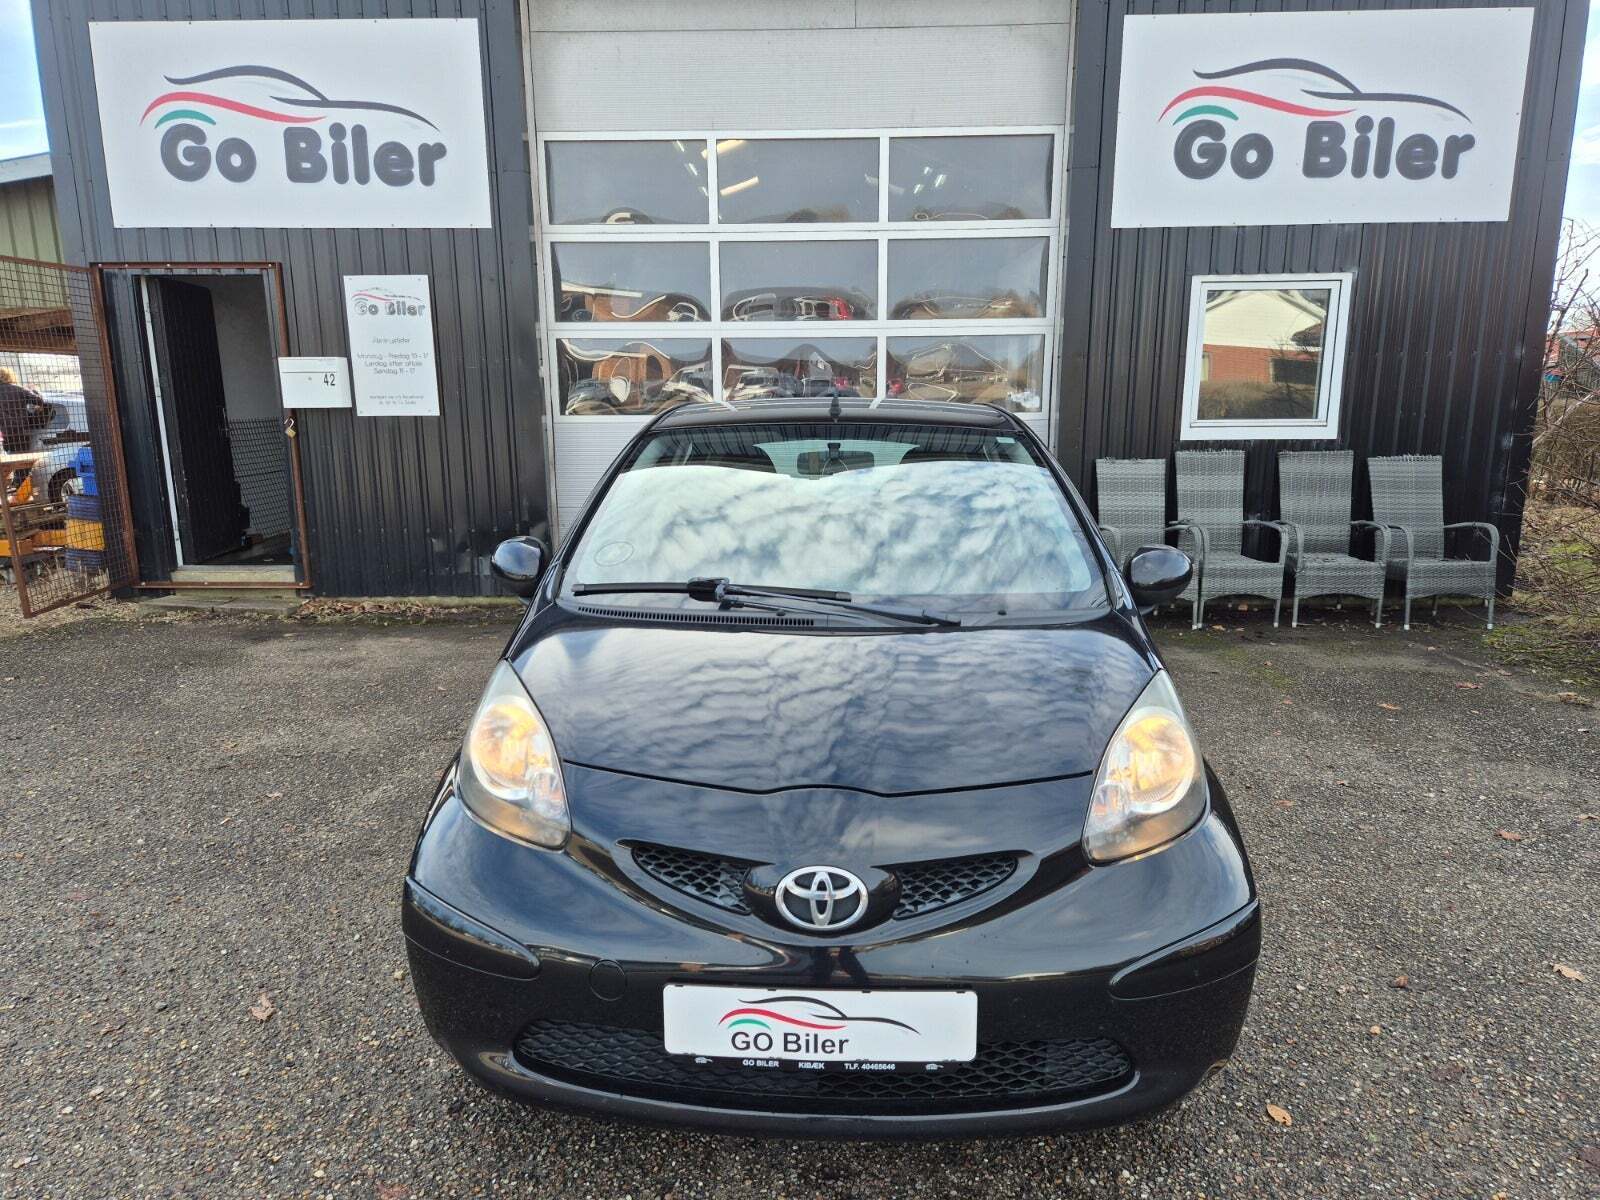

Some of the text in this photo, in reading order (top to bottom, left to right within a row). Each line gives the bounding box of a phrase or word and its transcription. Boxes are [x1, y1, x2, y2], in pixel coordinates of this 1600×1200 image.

[160, 122, 447, 187] Go Biler
[1173, 115, 1476, 180] Go Biler
[354, 300, 426, 316] Go Biler
[324, 373, 336, 386] 42
[731, 1031, 849, 1054] GO Biler
